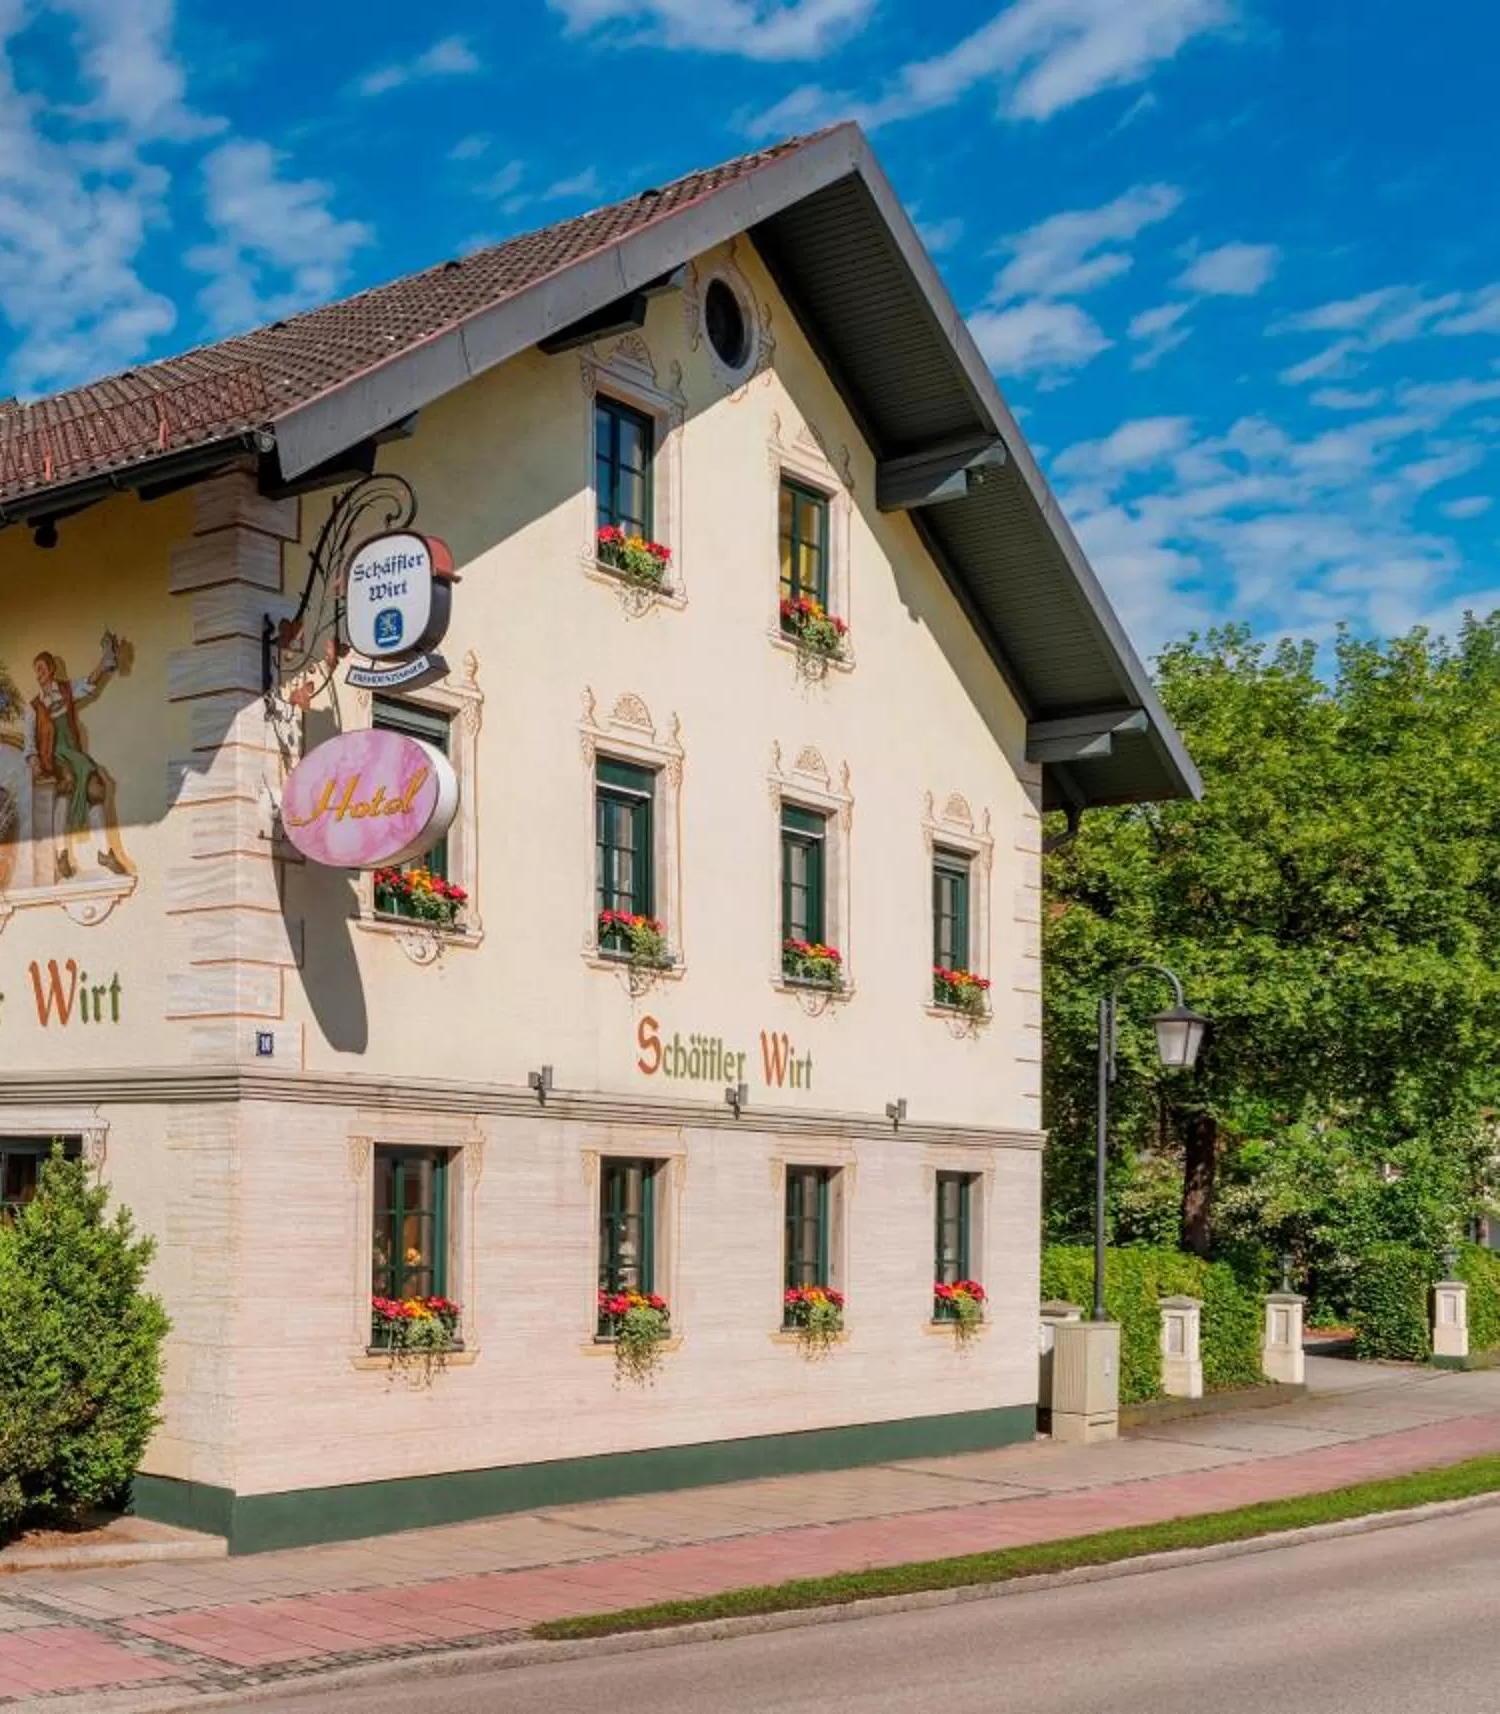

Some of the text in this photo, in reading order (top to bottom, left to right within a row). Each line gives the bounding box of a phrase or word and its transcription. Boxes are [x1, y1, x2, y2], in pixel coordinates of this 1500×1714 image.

[353, 553, 424, 582] Schäffler
[369, 581, 408, 602] Wirt
[288, 765, 429, 826] Hotel
[28, 957, 122, 1027] Wirt
[637, 1014, 813, 1089] Schäffler Wirt
